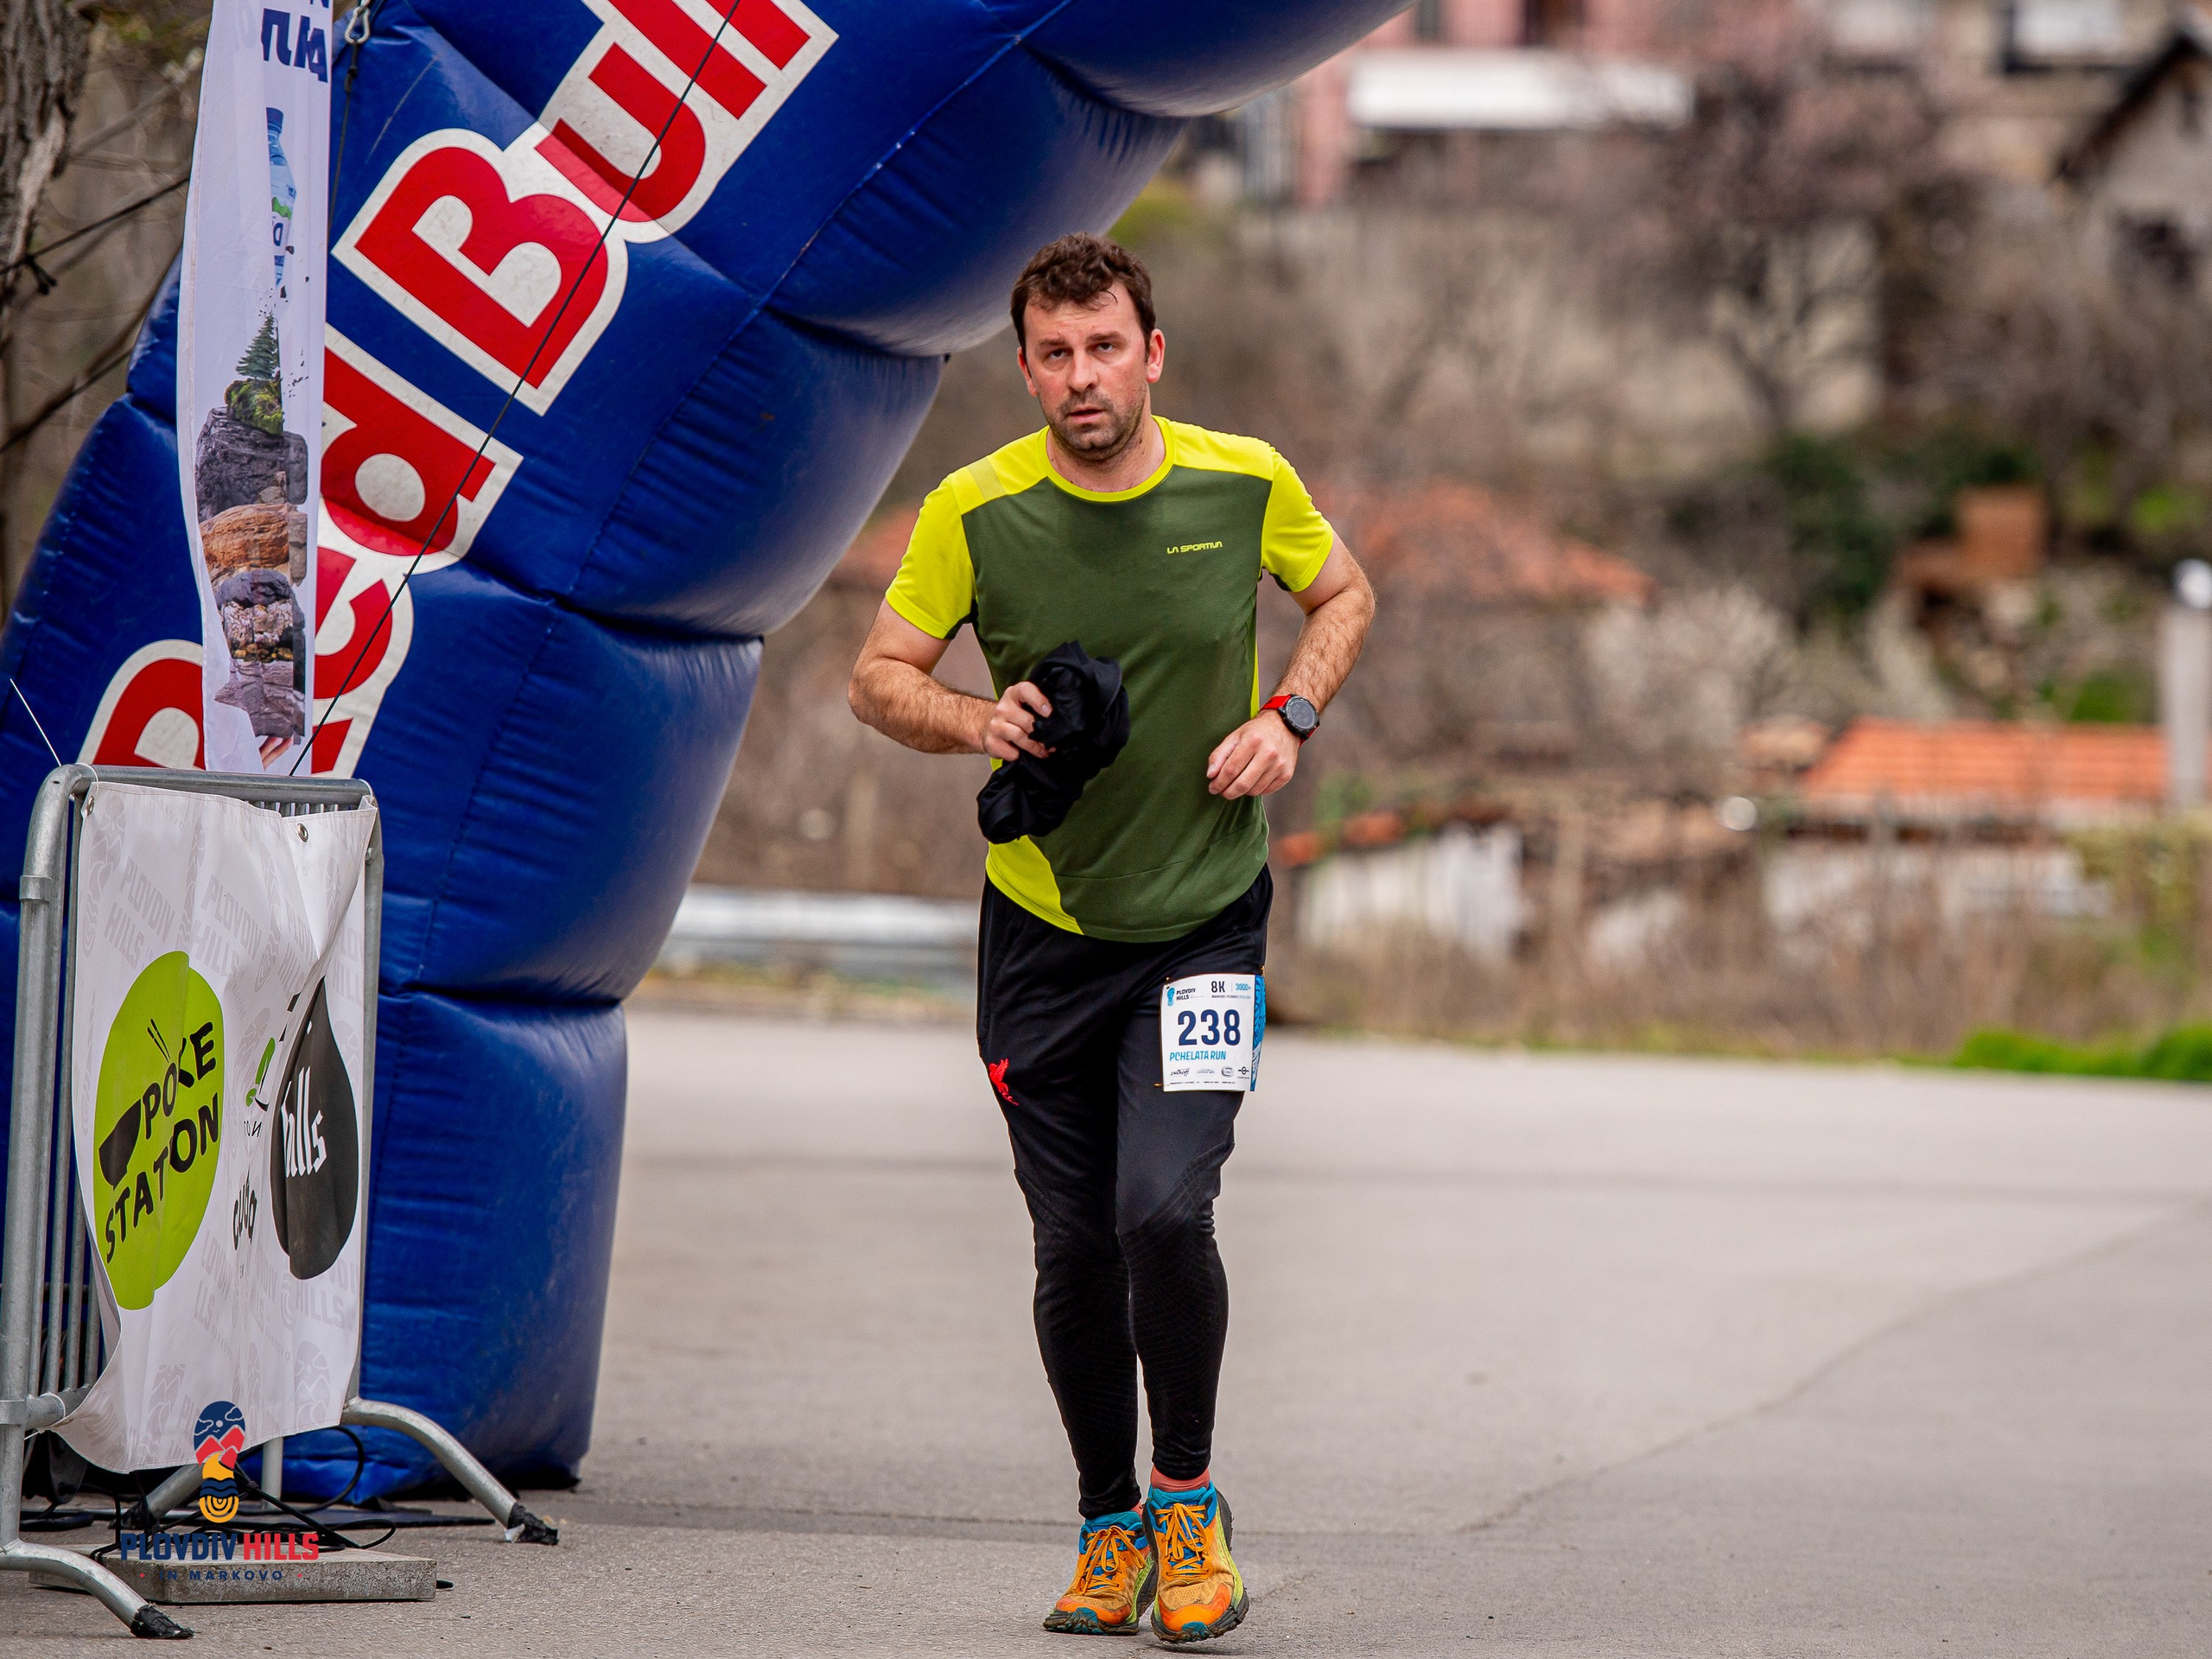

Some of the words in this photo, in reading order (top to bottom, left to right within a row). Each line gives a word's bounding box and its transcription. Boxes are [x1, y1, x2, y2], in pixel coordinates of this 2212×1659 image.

[1180, 541, 1223, 553] SPORTIVA
[1211, 981, 1225, 993] 8K
[1178, 1009, 1241, 1046] 238
[1169, 1051, 1209, 1062] PCHELATA
[1211, 1051, 1226, 1060] RUN
[143, 1021, 216, 1139] POKE
